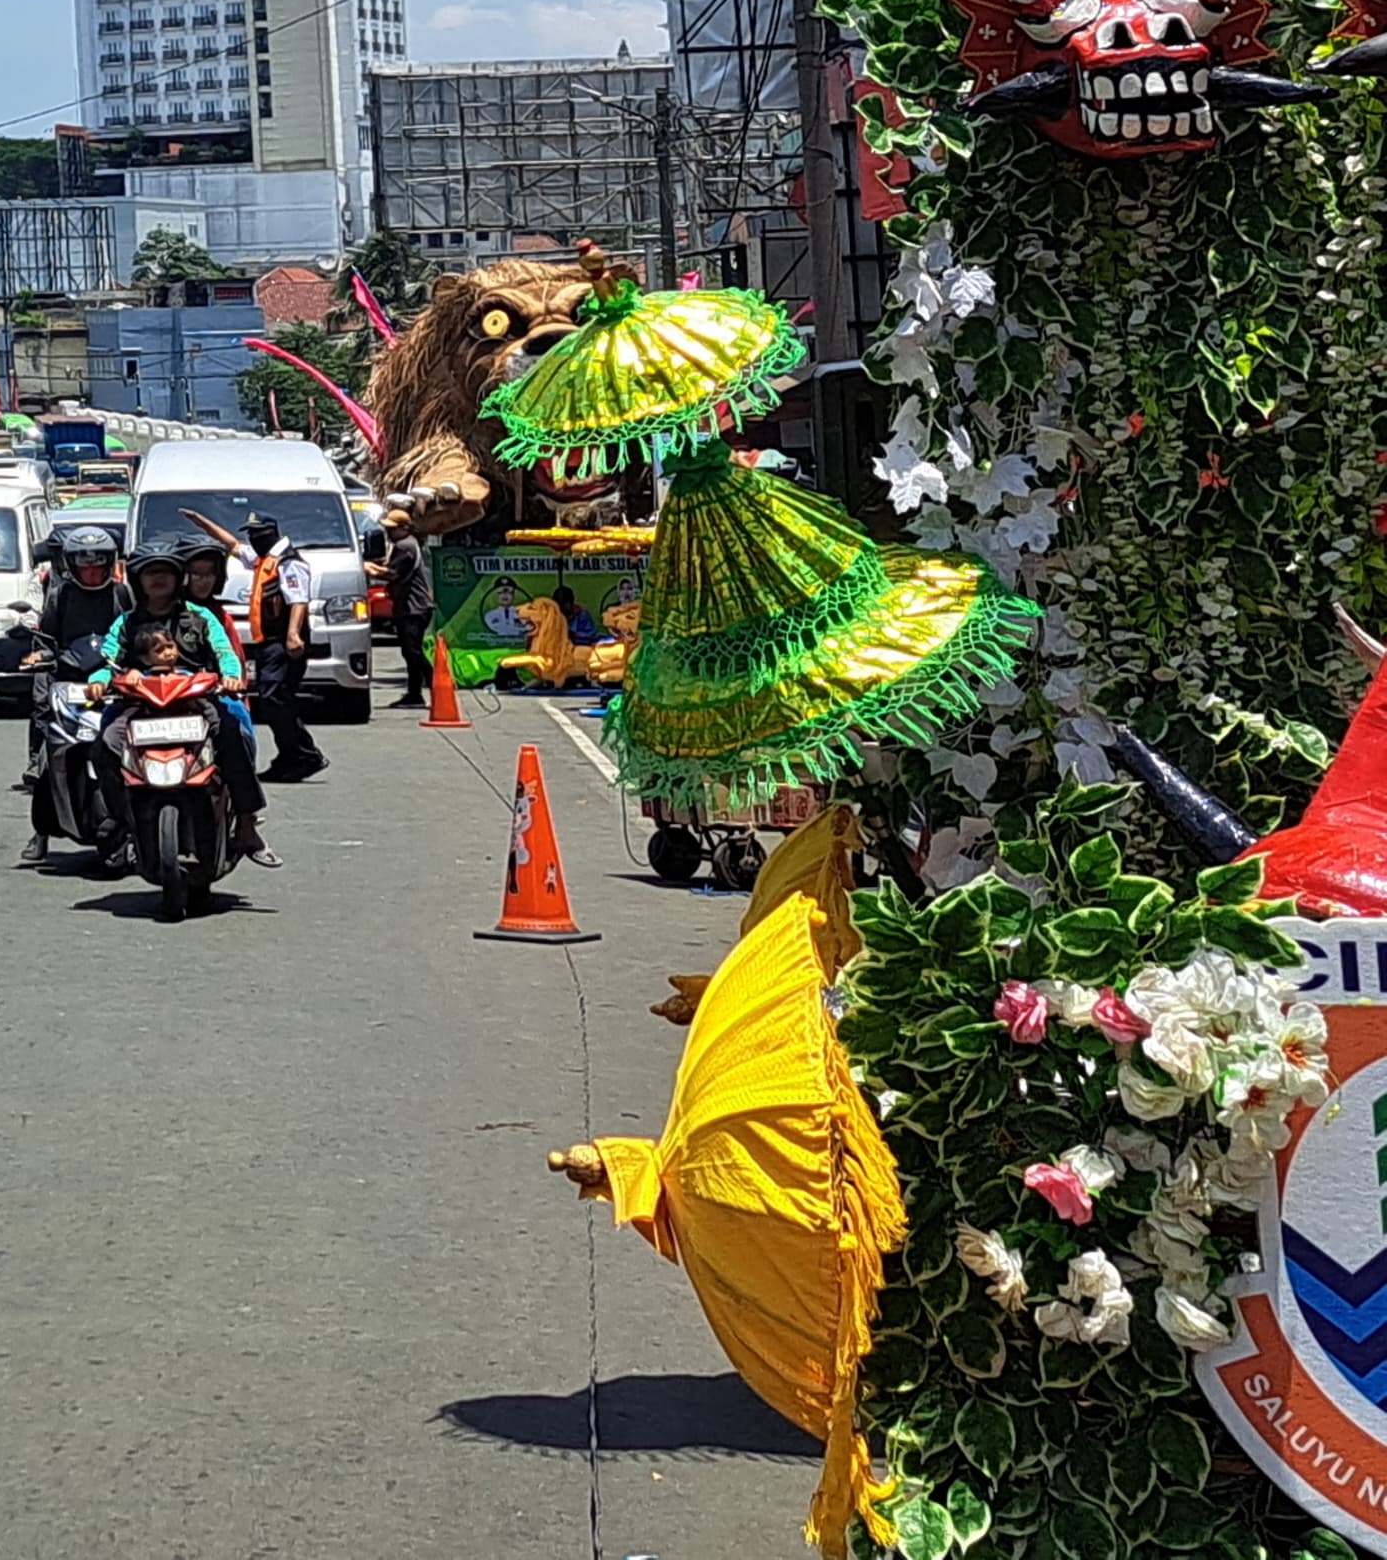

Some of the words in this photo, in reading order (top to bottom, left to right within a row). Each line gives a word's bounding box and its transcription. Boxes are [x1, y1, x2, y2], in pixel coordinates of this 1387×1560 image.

[475, 557, 500, 572] TIM
[1244, 1374, 1356, 1485] SALUYU
[1357, 1476, 1387, 1513] N
